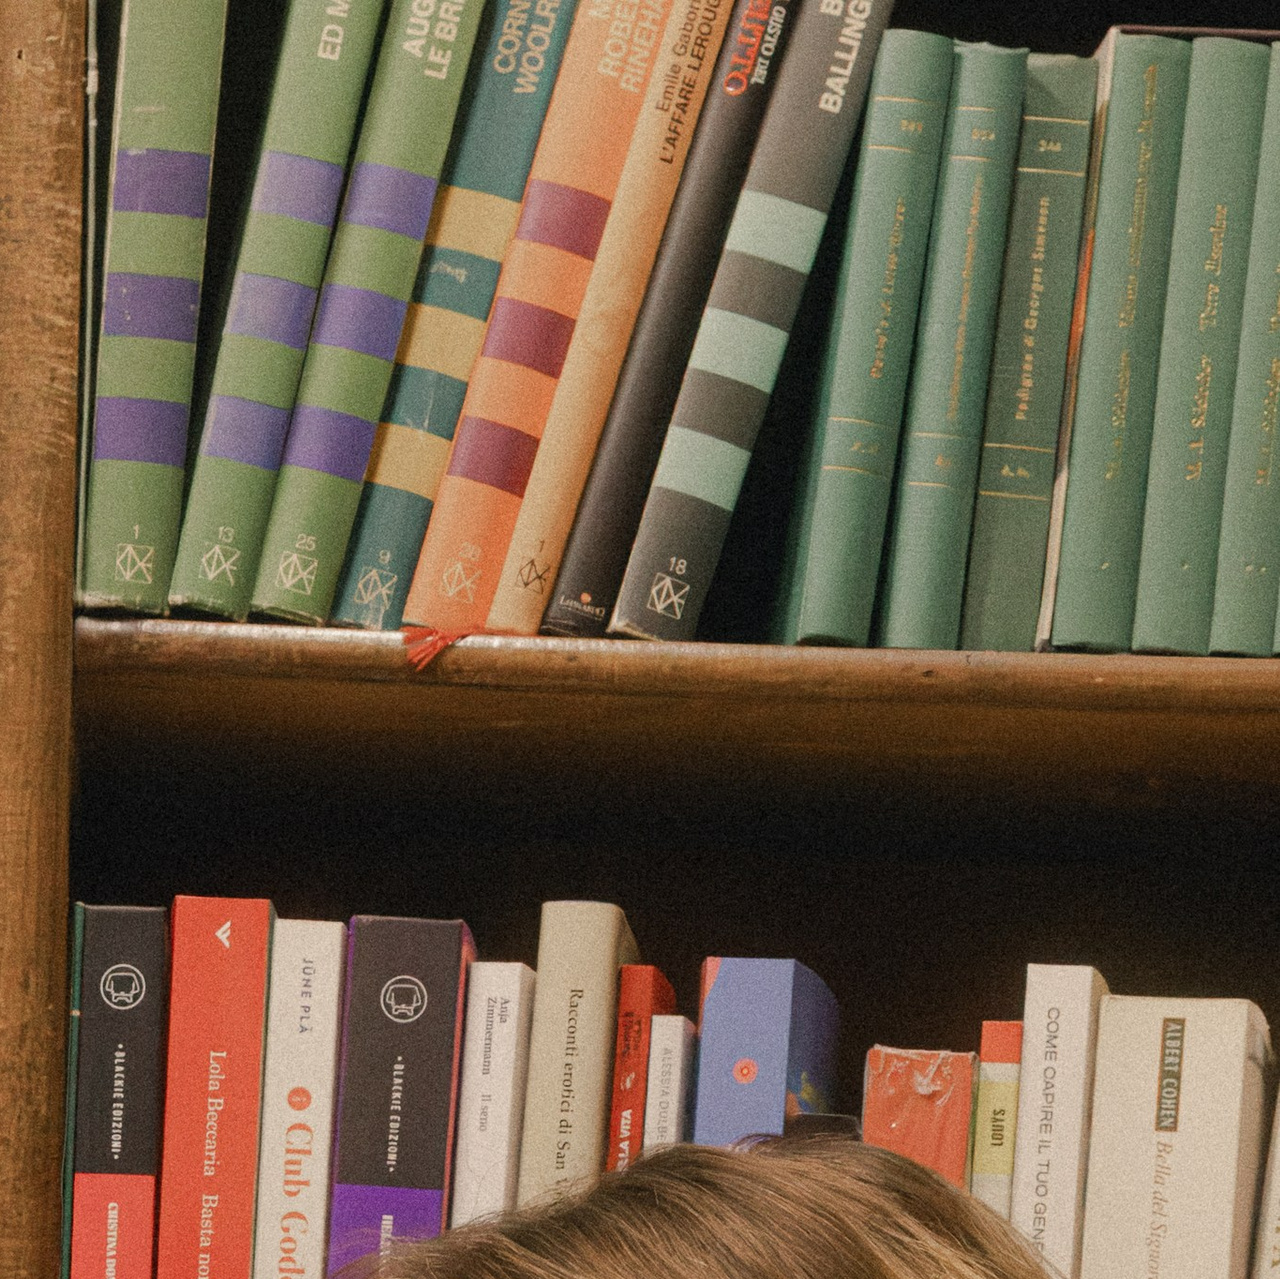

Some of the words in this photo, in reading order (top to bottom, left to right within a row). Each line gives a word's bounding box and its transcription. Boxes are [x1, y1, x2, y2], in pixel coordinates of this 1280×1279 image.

[295, 533, 317, 551] 25
[666, 555, 689, 575] 18
[496, 996, 510, 1023] Anja
[563, 988, 584, 1057] Racconti
[481, 996, 497, 1075] Zimmermann
[1162, 1022, 1182, 1072] ALBERT
[112, 1051, 125, 1098] BLACKIE
[207, 1050, 225, 1091] Lola
[390, 1063, 404, 1110] BLACKIE
[558, 1062, 577, 1113] erotici
[478, 1105, 488, 1132] seno
[480, 1093, 491, 1101] Il
[1158, 1077, 1178, 1128] COHEN
[110, 1102, 123, 1152] EDIZIONI
[202, 1096, 223, 1177] Beccaria
[386, 1115, 400, 1165] EDIZIONI
[558, 1118, 572, 1134] di
[281, 1121, 314, 1198] Club
[555, 1140, 569, 1170] San
[1152, 1140, 1173, 1185] Bella
[198, 1193, 218, 1247] Basta
[1150, 1190, 1171, 1218] del
[106, 1202, 118, 1256] CRISTINA
